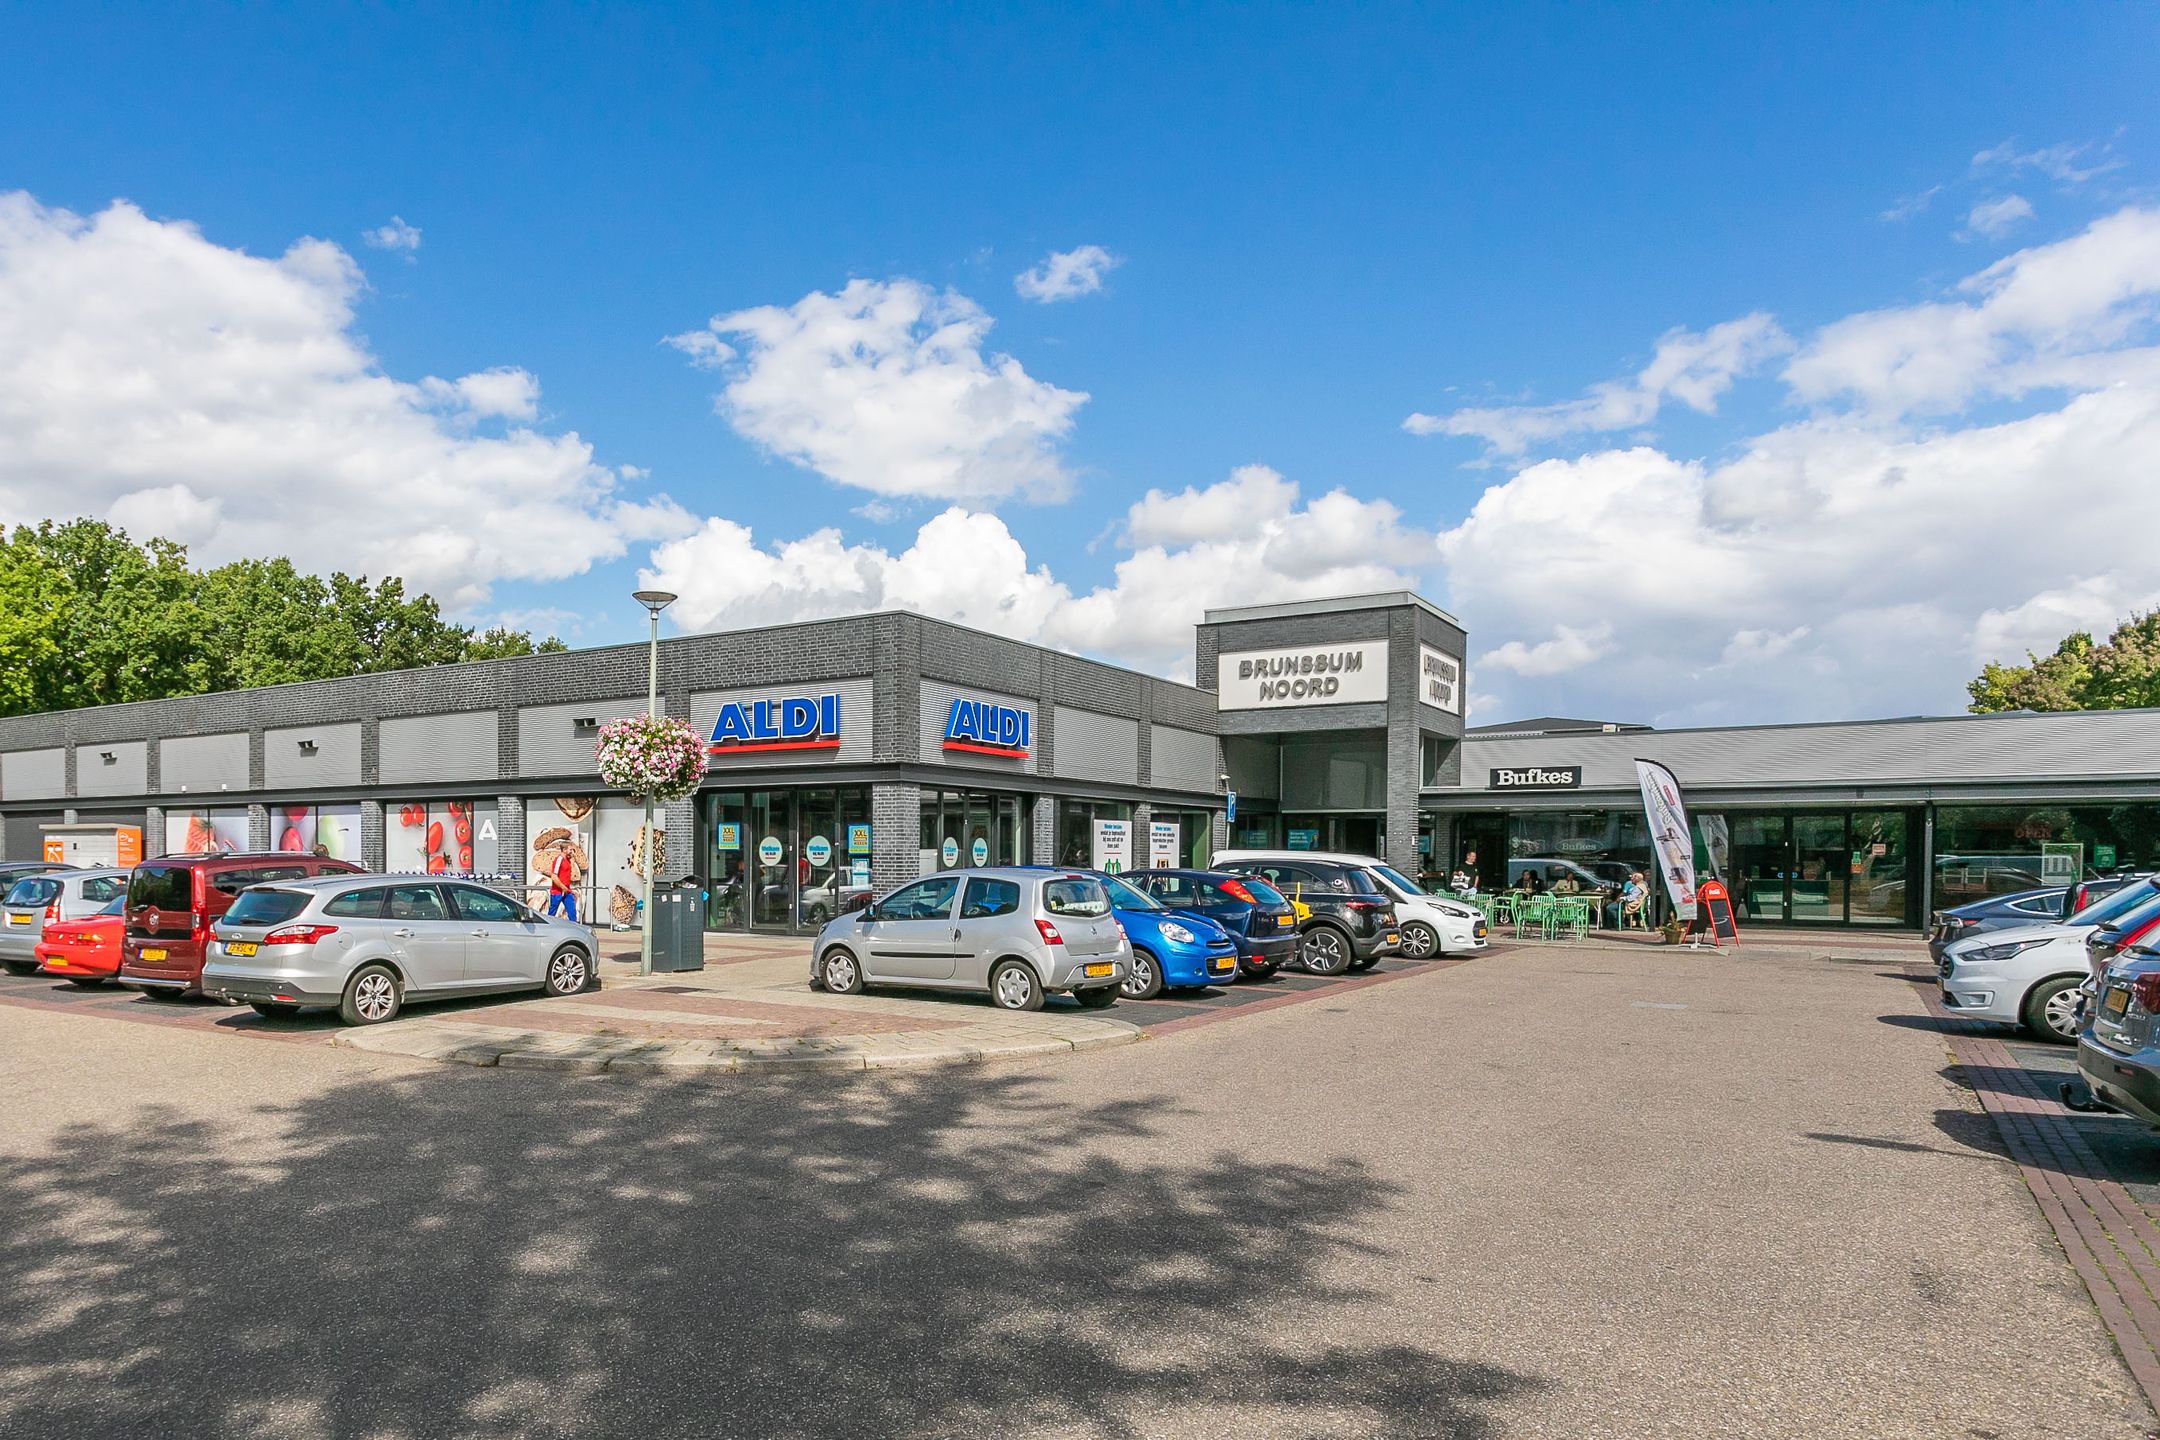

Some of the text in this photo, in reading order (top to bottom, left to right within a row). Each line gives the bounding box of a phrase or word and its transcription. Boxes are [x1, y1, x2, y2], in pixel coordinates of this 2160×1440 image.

[1239, 651, 1362, 680] BRUNSSUM
[1259, 676, 1339, 701] NOORD
[709, 694, 839, 742] ALDI
[943, 699, 1029, 747] ALDI
[1497, 768, 1573, 785] Bufkes
[479, 819, 497, 840] A
[1562, 843, 1597, 851] Bufkes
